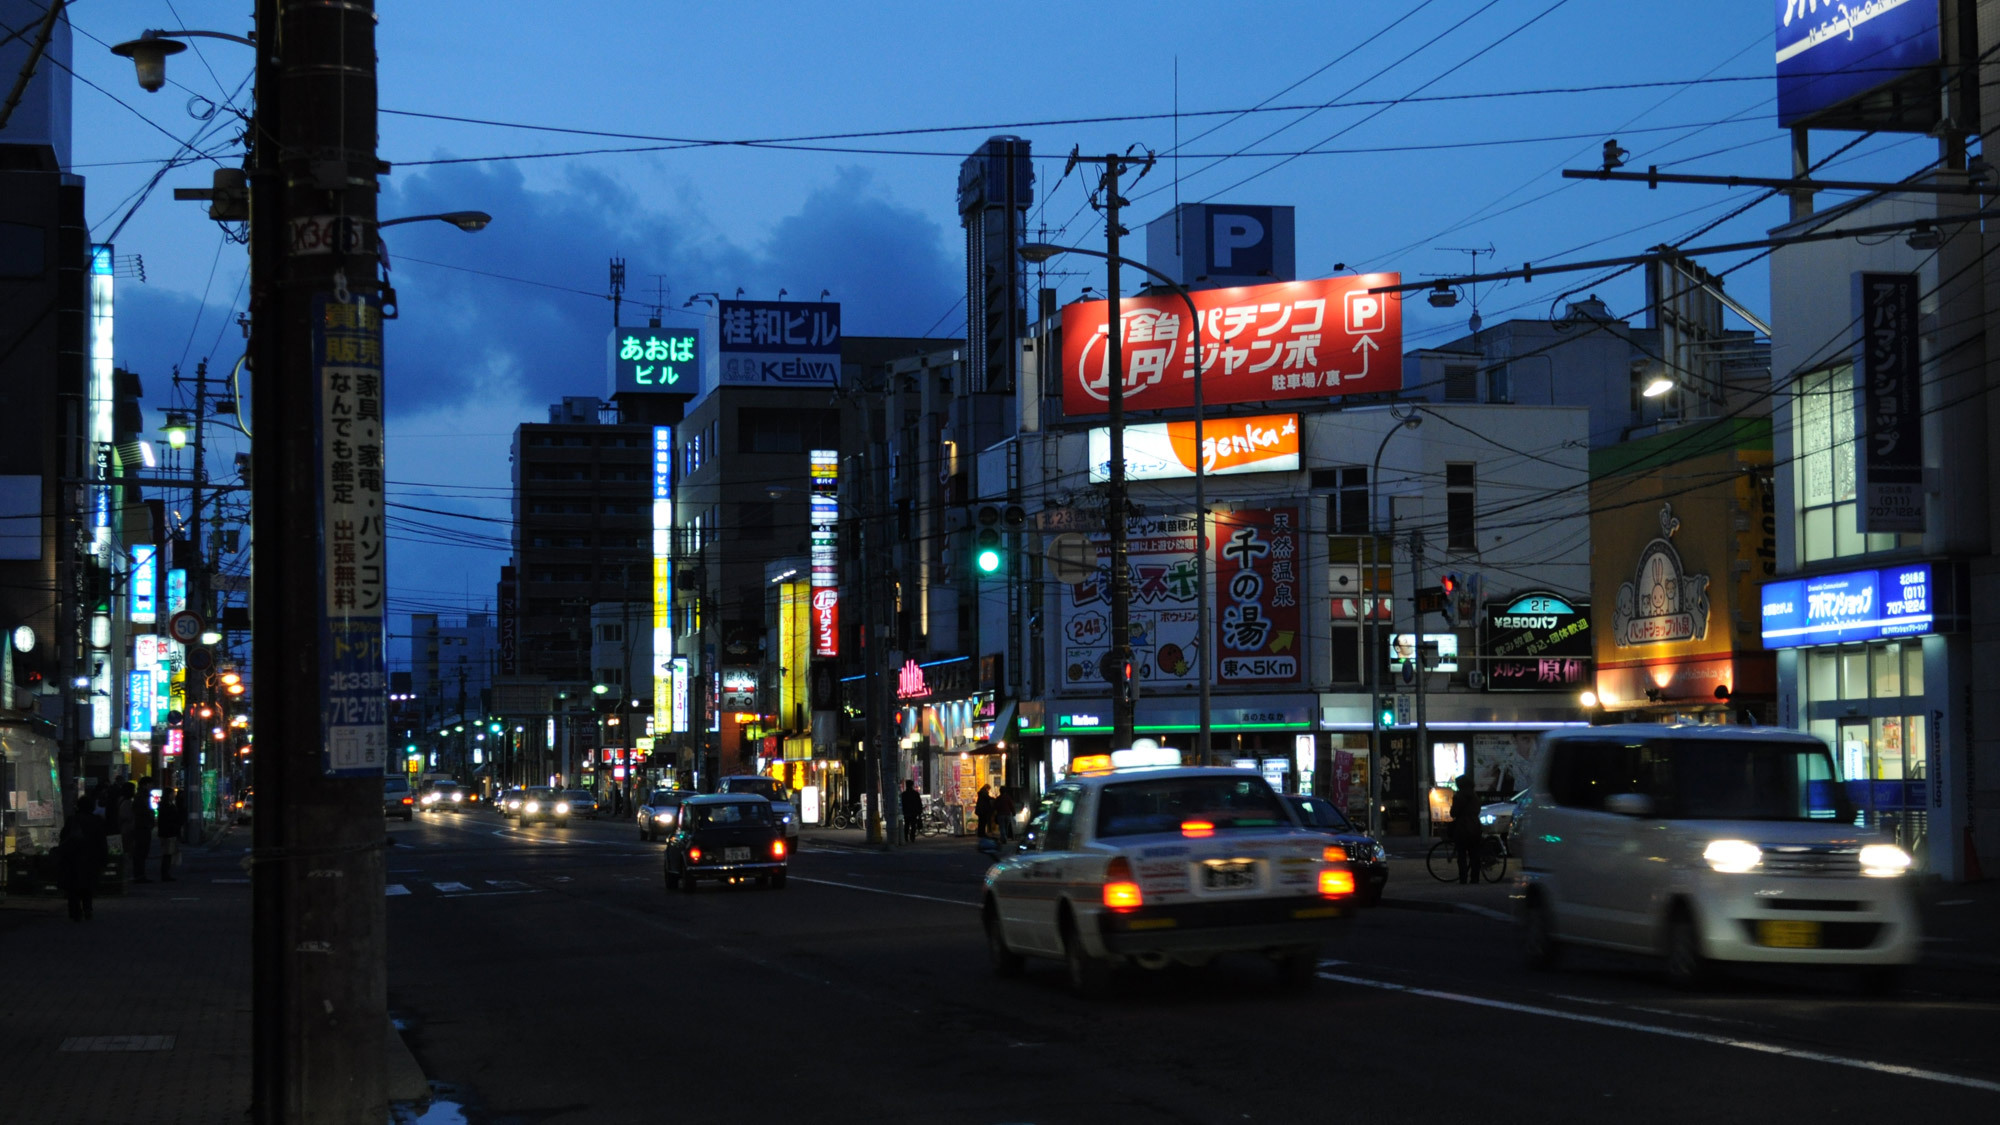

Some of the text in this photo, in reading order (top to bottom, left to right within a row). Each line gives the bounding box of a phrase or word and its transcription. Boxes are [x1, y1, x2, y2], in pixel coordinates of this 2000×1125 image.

[1212, 213, 1265, 268] P
[723, 307, 839, 348] 桂和ビル
[1187, 299, 1326, 341] パチンコ
[1352, 297, 1379, 328] P
[1127, 313, 1181, 343] 全台
[326, 336, 380, 366] 販売
[619, 335, 696, 362] あおば
[1182, 333, 1322, 379] ジャンボ
[635, 365, 690, 385] ビル
[1271, 369, 1342, 392] 駐車場/裏
[1872, 283, 1900, 456] アパマンショップ
[331, 373, 354, 505] なんでも鑑定
[1130, 461, 1168, 473] チェーン
[356, 374, 382, 610] 家具・家電・パソコン
[1880, 496, 1910, 506] (011)
[1869, 506, 1921, 517] 707-1224
[333, 520, 356, 609] 出張無料
[1271, 513, 1295, 608] 天然温泉
[1223, 528, 1270, 650] 千の湯
[1807, 586, 1873, 620] アパマンショップ
[1903, 585, 1926, 600] (011)
[1160, 612, 1200, 623] ボウリン
[1531, 600, 1550, 611] 2F
[1886, 599, 1926, 615] 707-1224
[177, 619, 196, 634] 50
[820, 609, 832, 647] パチンコ
[1526, 617, 1589, 656] 持込・団体歓迎
[1630, 616, 1690, 640] ペットショップ小泉
[1494, 630, 1535, 657] 飲み放題
